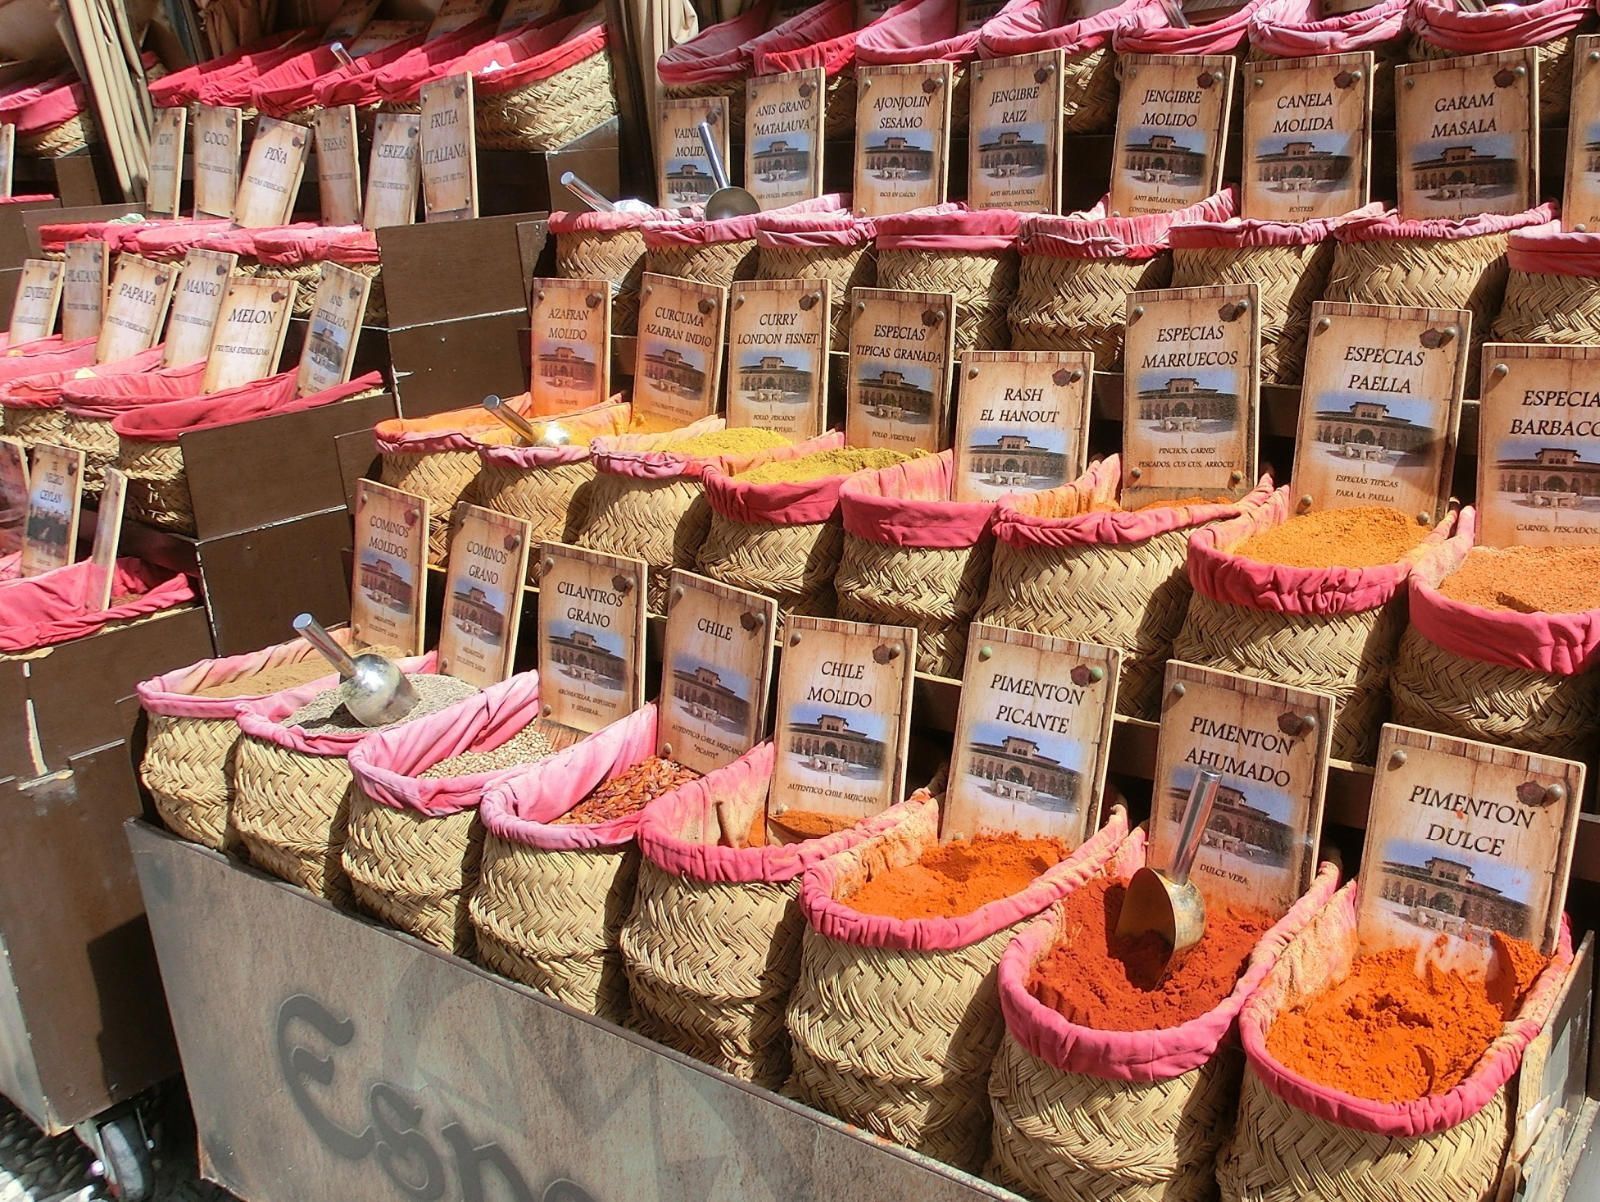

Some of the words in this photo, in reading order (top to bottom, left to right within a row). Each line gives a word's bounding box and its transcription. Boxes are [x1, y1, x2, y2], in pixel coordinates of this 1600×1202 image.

[874, 96, 932, 111] AJONJOLIN
[990, 86, 1039, 107] JENGIBRE
[1141, 90, 1202, 106] JENGIBRE
[1277, 92, 1333, 110] CANELA
[1434, 92, 1495, 113] GARAM
[756, 104, 776, 117] ANIS
[778, 98, 811, 114] GRANO
[1002, 110, 1027, 124] RAIZ
[430, 110, 458, 128] FRUTA
[880, 117, 922, 130] SESAMO
[1142, 113, 1198, 127] MOLIDO
[1272, 118, 1334, 134] MOLIDA
[1431, 117, 1497, 138] MASALA
[204, 131, 230, 146] COCO
[264, 147, 288, 164] PIÑA
[378, 144, 416, 160] CEREZAS
[424, 144, 466, 165] ITALIANA
[675, 146, 705, 157] MOLID
[120, 284, 156, 306] PAPAYA
[184, 278, 220, 297] MANGO
[228, 308, 278, 324] MELON
[548, 308, 590, 321] AZAFRAN
[655, 306, 704, 328] CURCUMA
[759, 313, 798, 326] CURRY
[548, 327, 588, 340] MOLIDO
[645, 325, 682, 340] AZAFRAN
[685, 331, 712, 348] INDIO
[738, 333, 784, 344] LONDON
[784, 332, 818, 344] FISNET
[874, 324, 926, 342] ESPECIAS
[1156, 325, 1224, 342] ESPECIAS
[856, 344, 890, 358] TIPICAS
[893, 348, 942, 364] GRANADA
[1140, 350, 1238, 368] MARRUECOS
[1344, 346, 1426, 368] ESPECIAS
[1347, 374, 1412, 394] PAELLA
[1004, 388, 1044, 402] RASH
[980, 409, 995, 422] EL
[999, 410, 1060, 424] HANOUT
[1336, 474, 1368, 484] ESPECIAS
[1370, 478, 1399, 488] TIPICAS
[1336, 489, 1354, 498] PARA
[1368, 493, 1394, 502] PAELLA
[370, 515, 409, 538] COMINOS
[368, 536, 408, 560] MOLIDOS
[466, 540, 508, 565] COMINOS
[468, 564, 499, 584] GRANO
[557, 582, 625, 608] CILANTROS
[567, 607, 611, 628] GRANO
[697, 618, 734, 640] CHILE
[822, 660, 864, 680] CHILE
[807, 686, 872, 708] MOLIDO
[990, 674, 1084, 706] PIMENTON
[994, 704, 1070, 735] PICANTE
[1189, 716, 1295, 756] PIMENTON
[1184, 746, 1291, 788] AHUMADO
[788, 784, 824, 794] AUTENTICO
[824, 789, 842, 798] CHILE
[1408, 784, 1536, 830] PIMENTON
[1425, 823, 1505, 858] DULCE
[1200, 864, 1227, 878] DULCE
